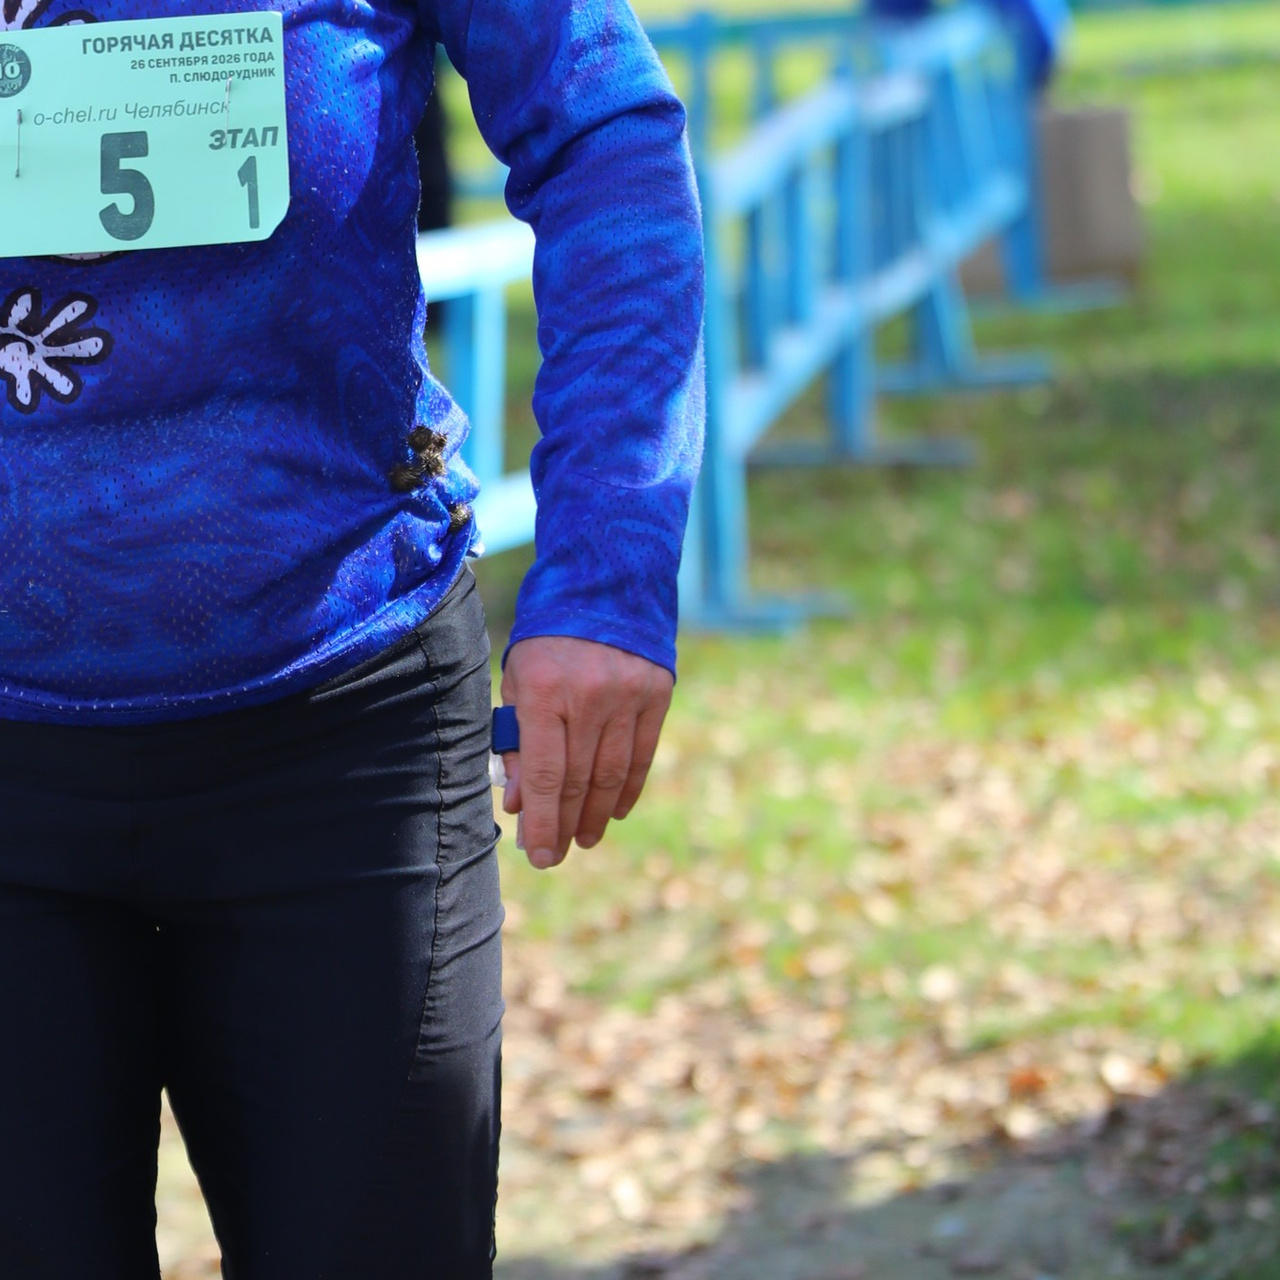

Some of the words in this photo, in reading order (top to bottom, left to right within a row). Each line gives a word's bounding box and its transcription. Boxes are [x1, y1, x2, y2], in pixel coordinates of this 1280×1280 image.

[82, 33, 174, 55] ГОРЯЧАЯ
[179, 26, 274, 51] ДЕСЯТКА
[130, 59, 146, 70] 26
[148, 55, 209, 69] СЕНТЯБРЯ
[211, 53, 241, 65] 2026
[243, 51, 275, 63] ГОДА
[169, 72, 181, 84] П.
[183, 67, 276, 83] СЛЮДОРУДНИК
[33, 105, 118, 126] o-chel.ru
[124, 99, 230, 121] Челябинск
[208, 126, 280, 151] ЭТАП
[98, 130, 156, 241] 5
[236, 154, 260, 230] 1
